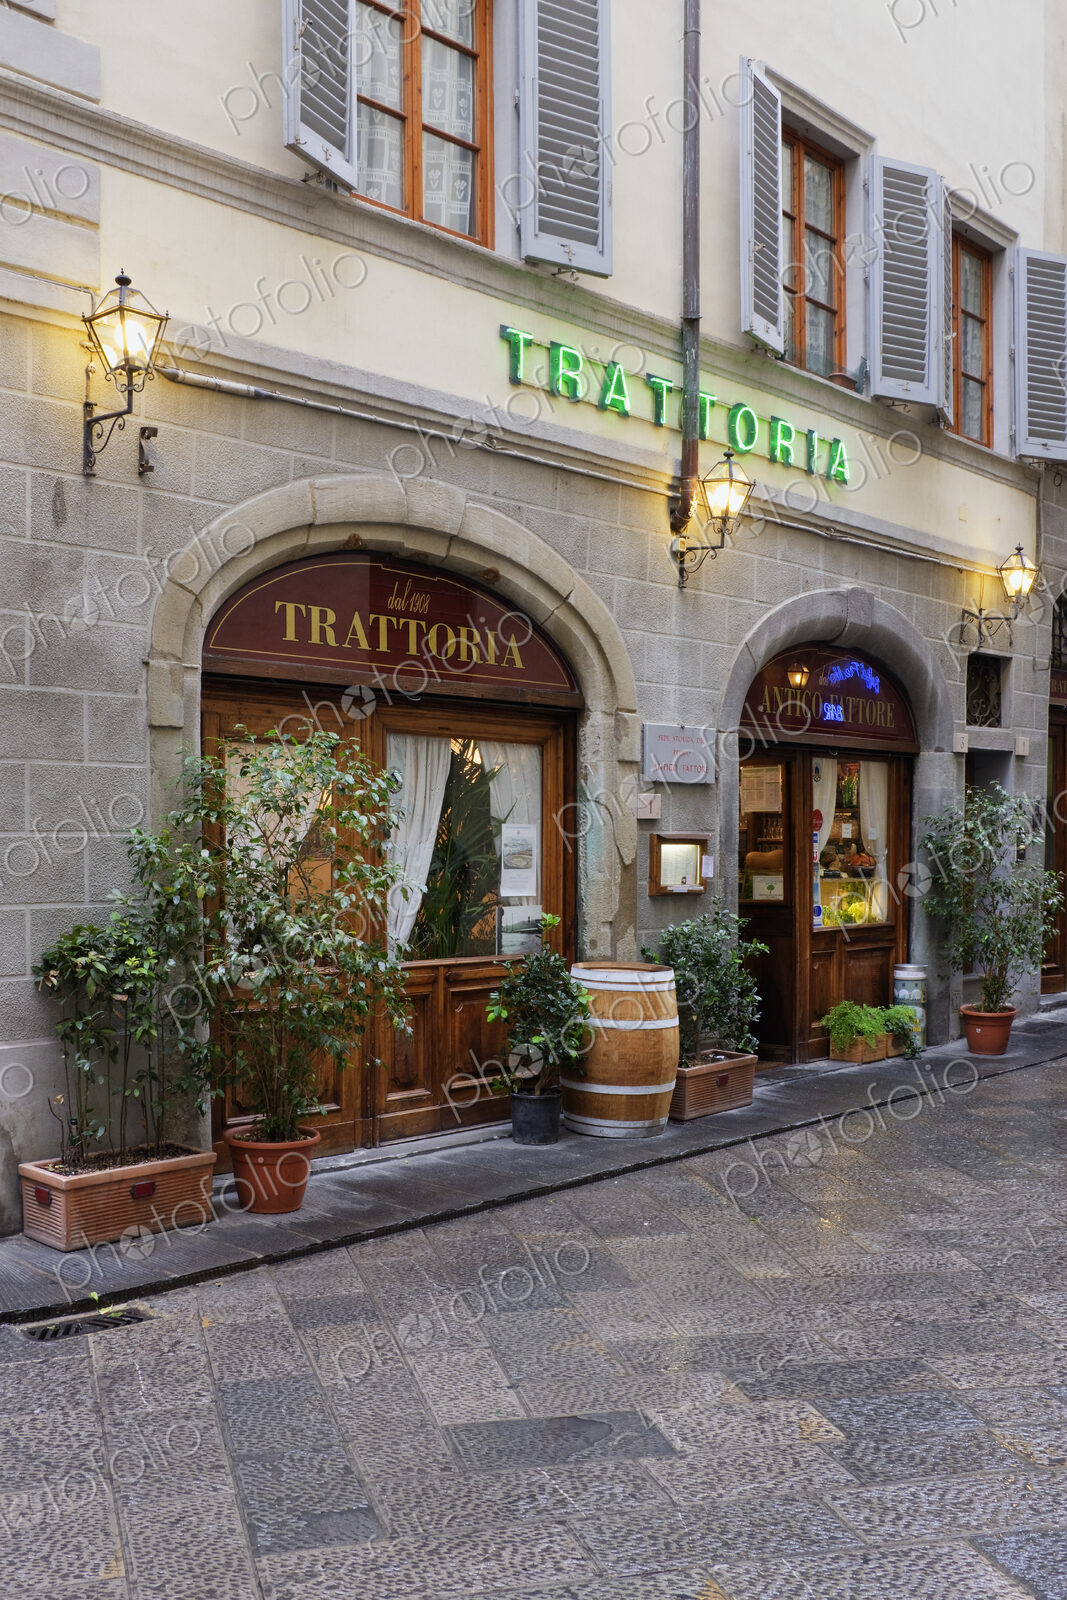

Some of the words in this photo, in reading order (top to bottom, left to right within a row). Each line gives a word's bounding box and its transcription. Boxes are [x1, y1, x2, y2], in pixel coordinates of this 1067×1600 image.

[499, 324, 851, 486] TRATTORIA
[388, 579, 411, 610] dal
[410, 592, 430, 613] 1908
[274, 600, 526, 669] TRATTORIA
[762, 684, 823, 719] ANTICO
